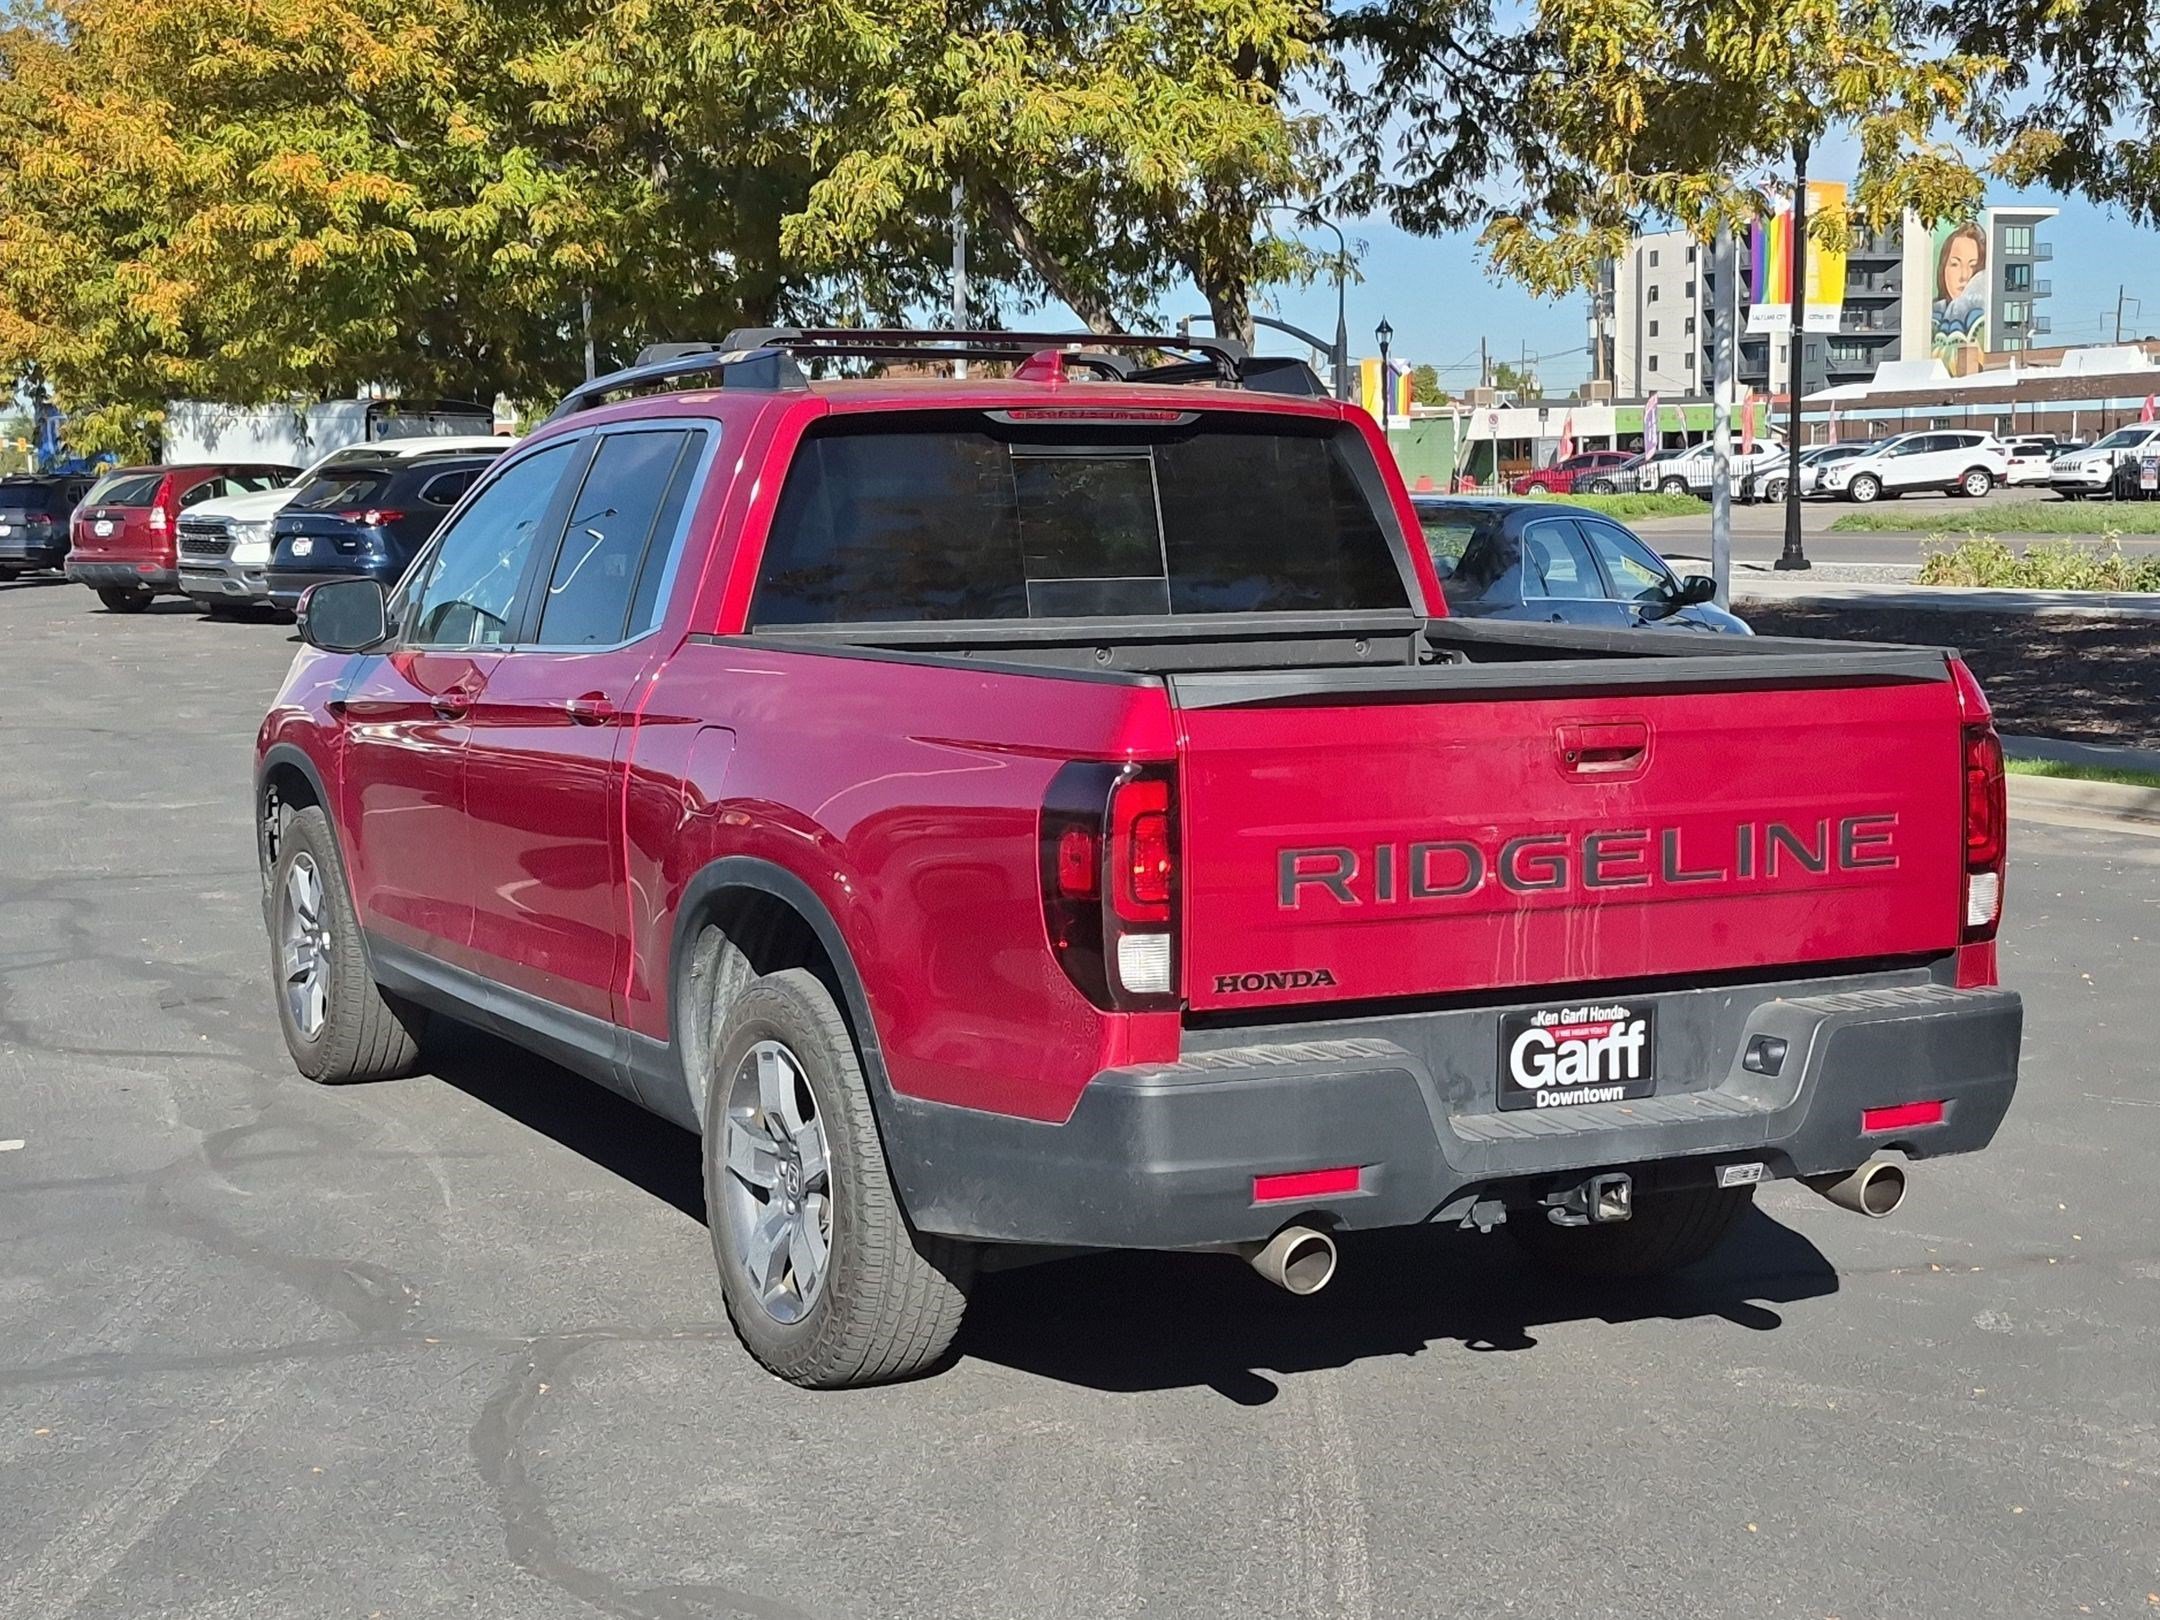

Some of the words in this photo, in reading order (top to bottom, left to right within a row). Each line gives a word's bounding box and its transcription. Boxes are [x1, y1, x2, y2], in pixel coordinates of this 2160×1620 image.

[1279, 813, 1899, 909] RIDGELINE
[1214, 968, 1337, 994] HONDA
[1537, 1010, 1559, 1026] Ken
[1560, 1007, 1588, 1025] Garff
[1589, 1004, 1624, 1022] Honda
[1510, 1019, 1646, 1089] Garff
[1536, 1086, 1624, 1108] Downtown
